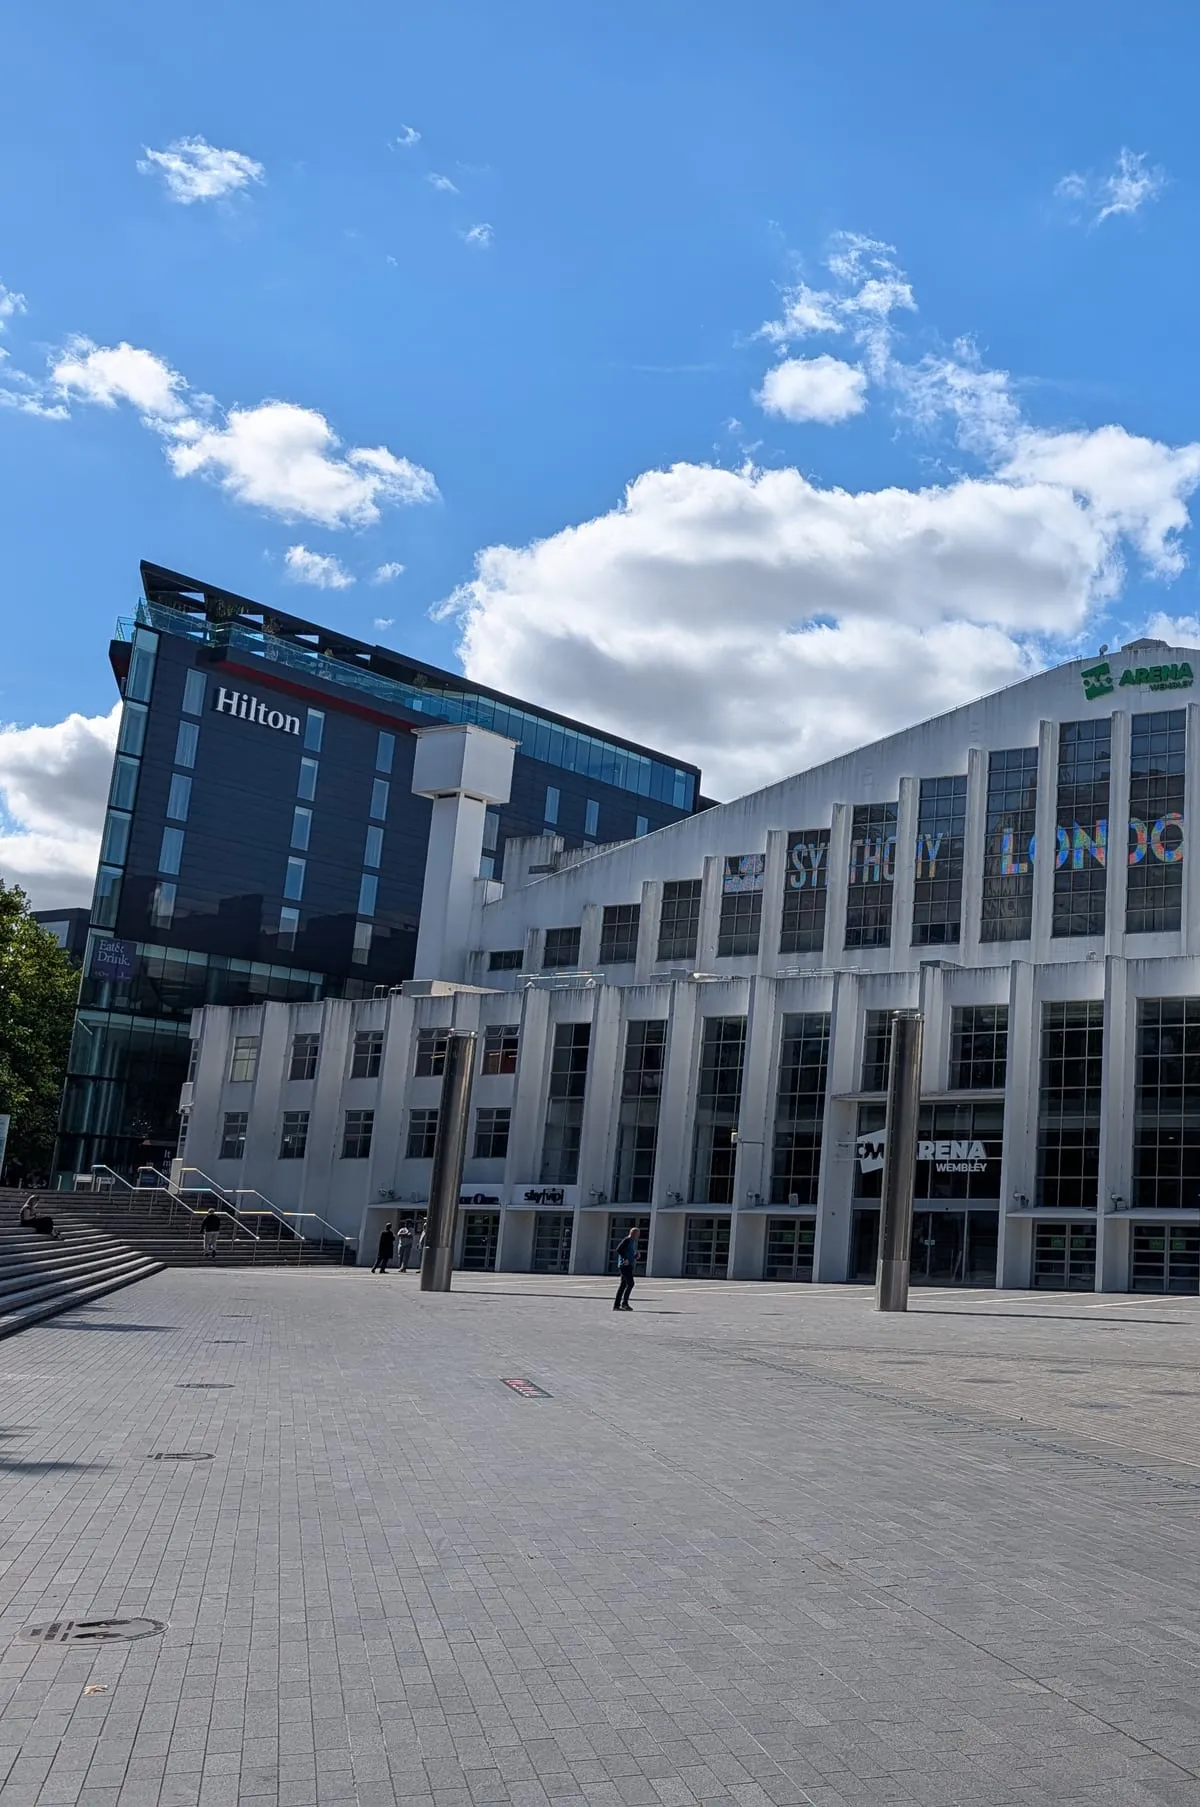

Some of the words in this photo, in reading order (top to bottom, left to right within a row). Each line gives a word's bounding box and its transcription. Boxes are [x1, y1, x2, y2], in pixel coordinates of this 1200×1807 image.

[1119, 662, 1194, 686] ARENA
[216, 686, 300, 736] Hilton
[916, 1140, 987, 1160] RENA
[936, 1162, 988, 1173] WEMBLEY
